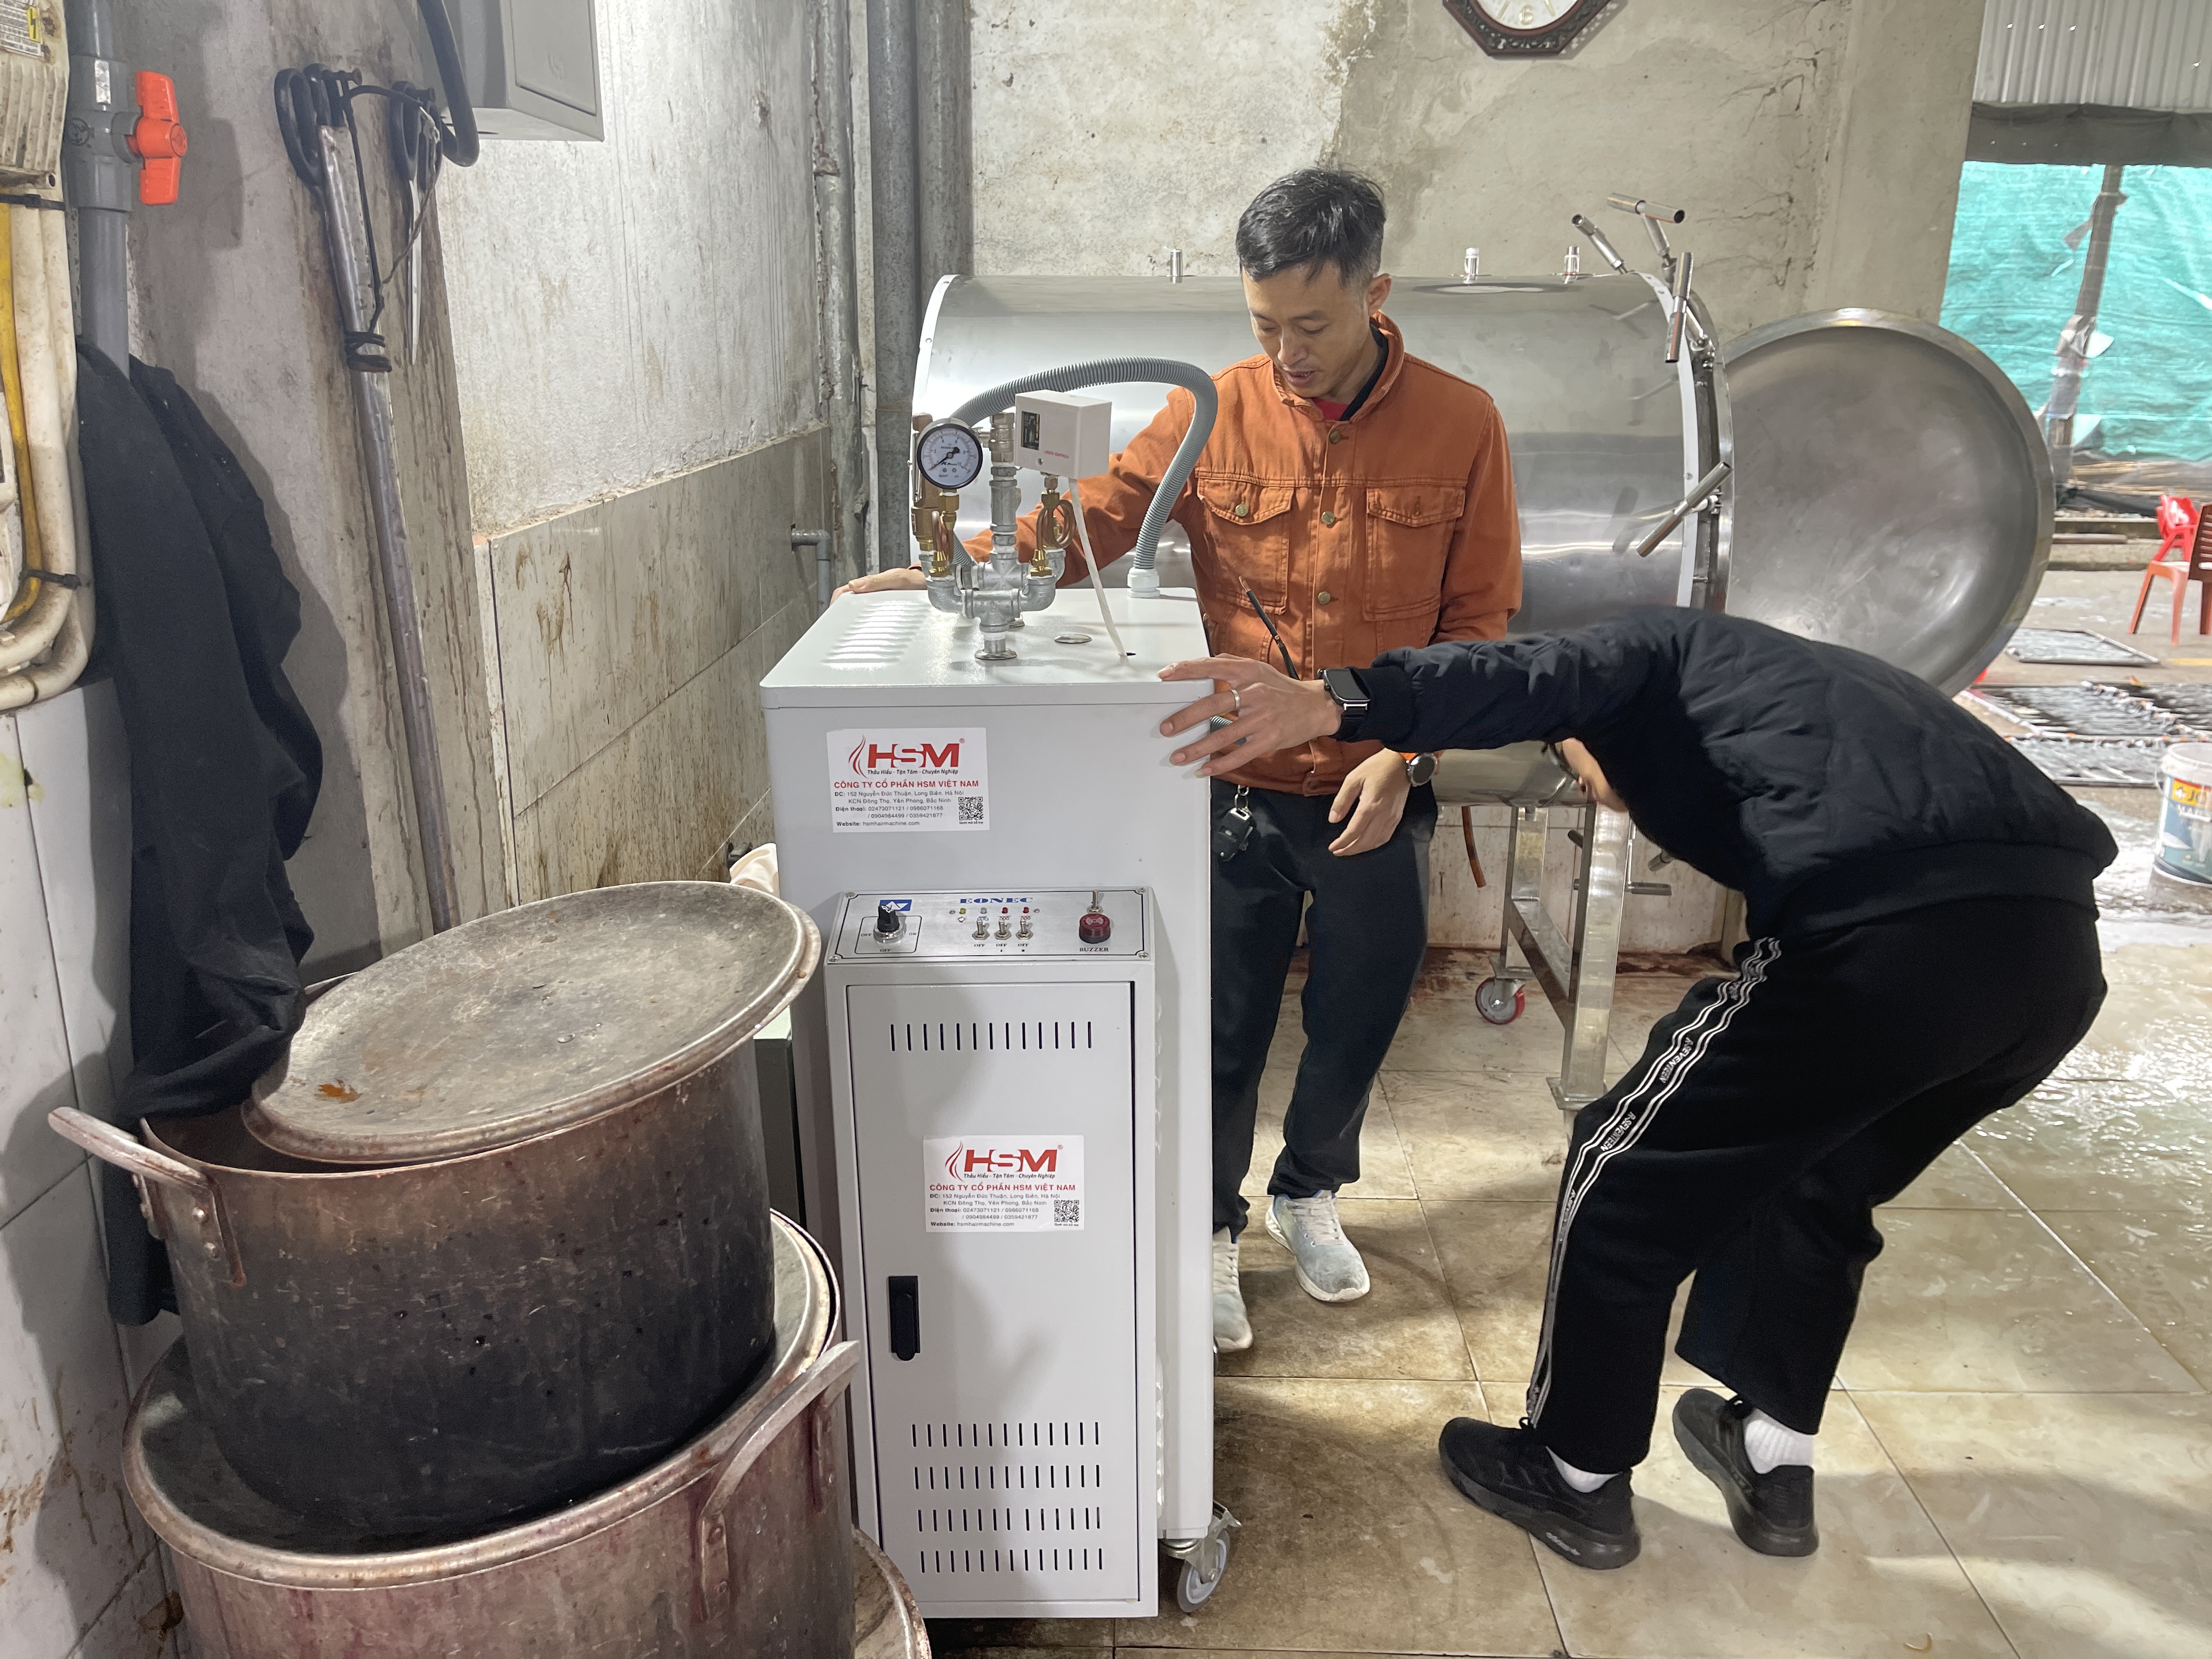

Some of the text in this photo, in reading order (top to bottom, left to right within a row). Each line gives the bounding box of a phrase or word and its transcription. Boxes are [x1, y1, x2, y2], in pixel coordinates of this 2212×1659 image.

[1519, 4, 1533, 25] 6
[867, 743, 960, 768] HSM
[834, 780, 859, 788] CÔNG
[939, 779, 957, 788] VIỆT
[964, 1149, 1058, 1172] HSM
[1035, 1183, 1054, 1192] VIỆT
